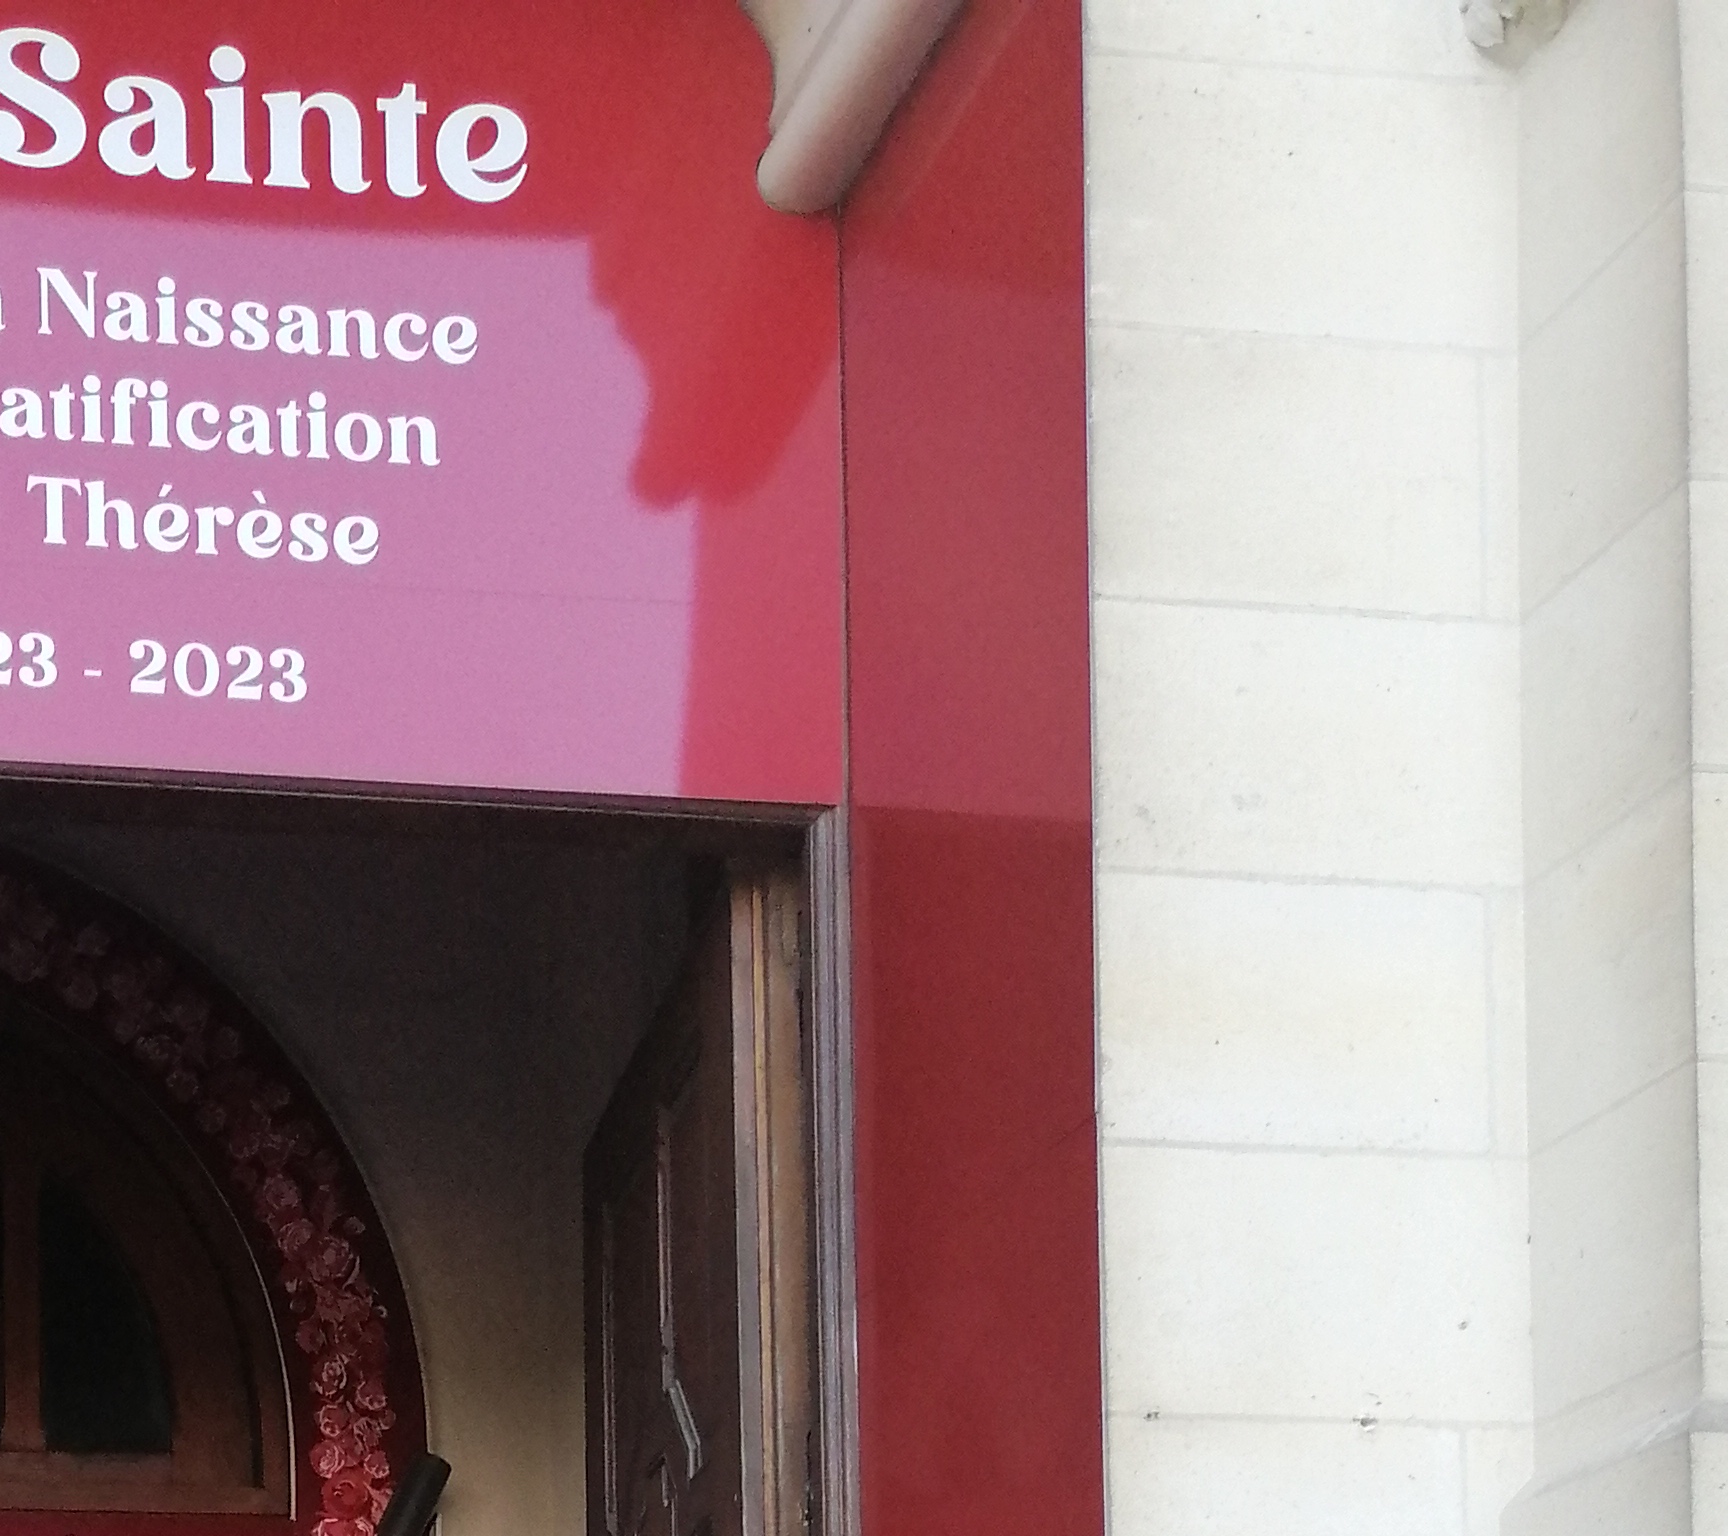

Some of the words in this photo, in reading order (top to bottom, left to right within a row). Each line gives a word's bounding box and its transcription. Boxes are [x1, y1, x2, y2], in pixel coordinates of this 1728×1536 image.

[37, 268, 478, 364] Naissance
[27, 475, 378, 565] Thérèse
[130, 640, 307, 702] 2023
